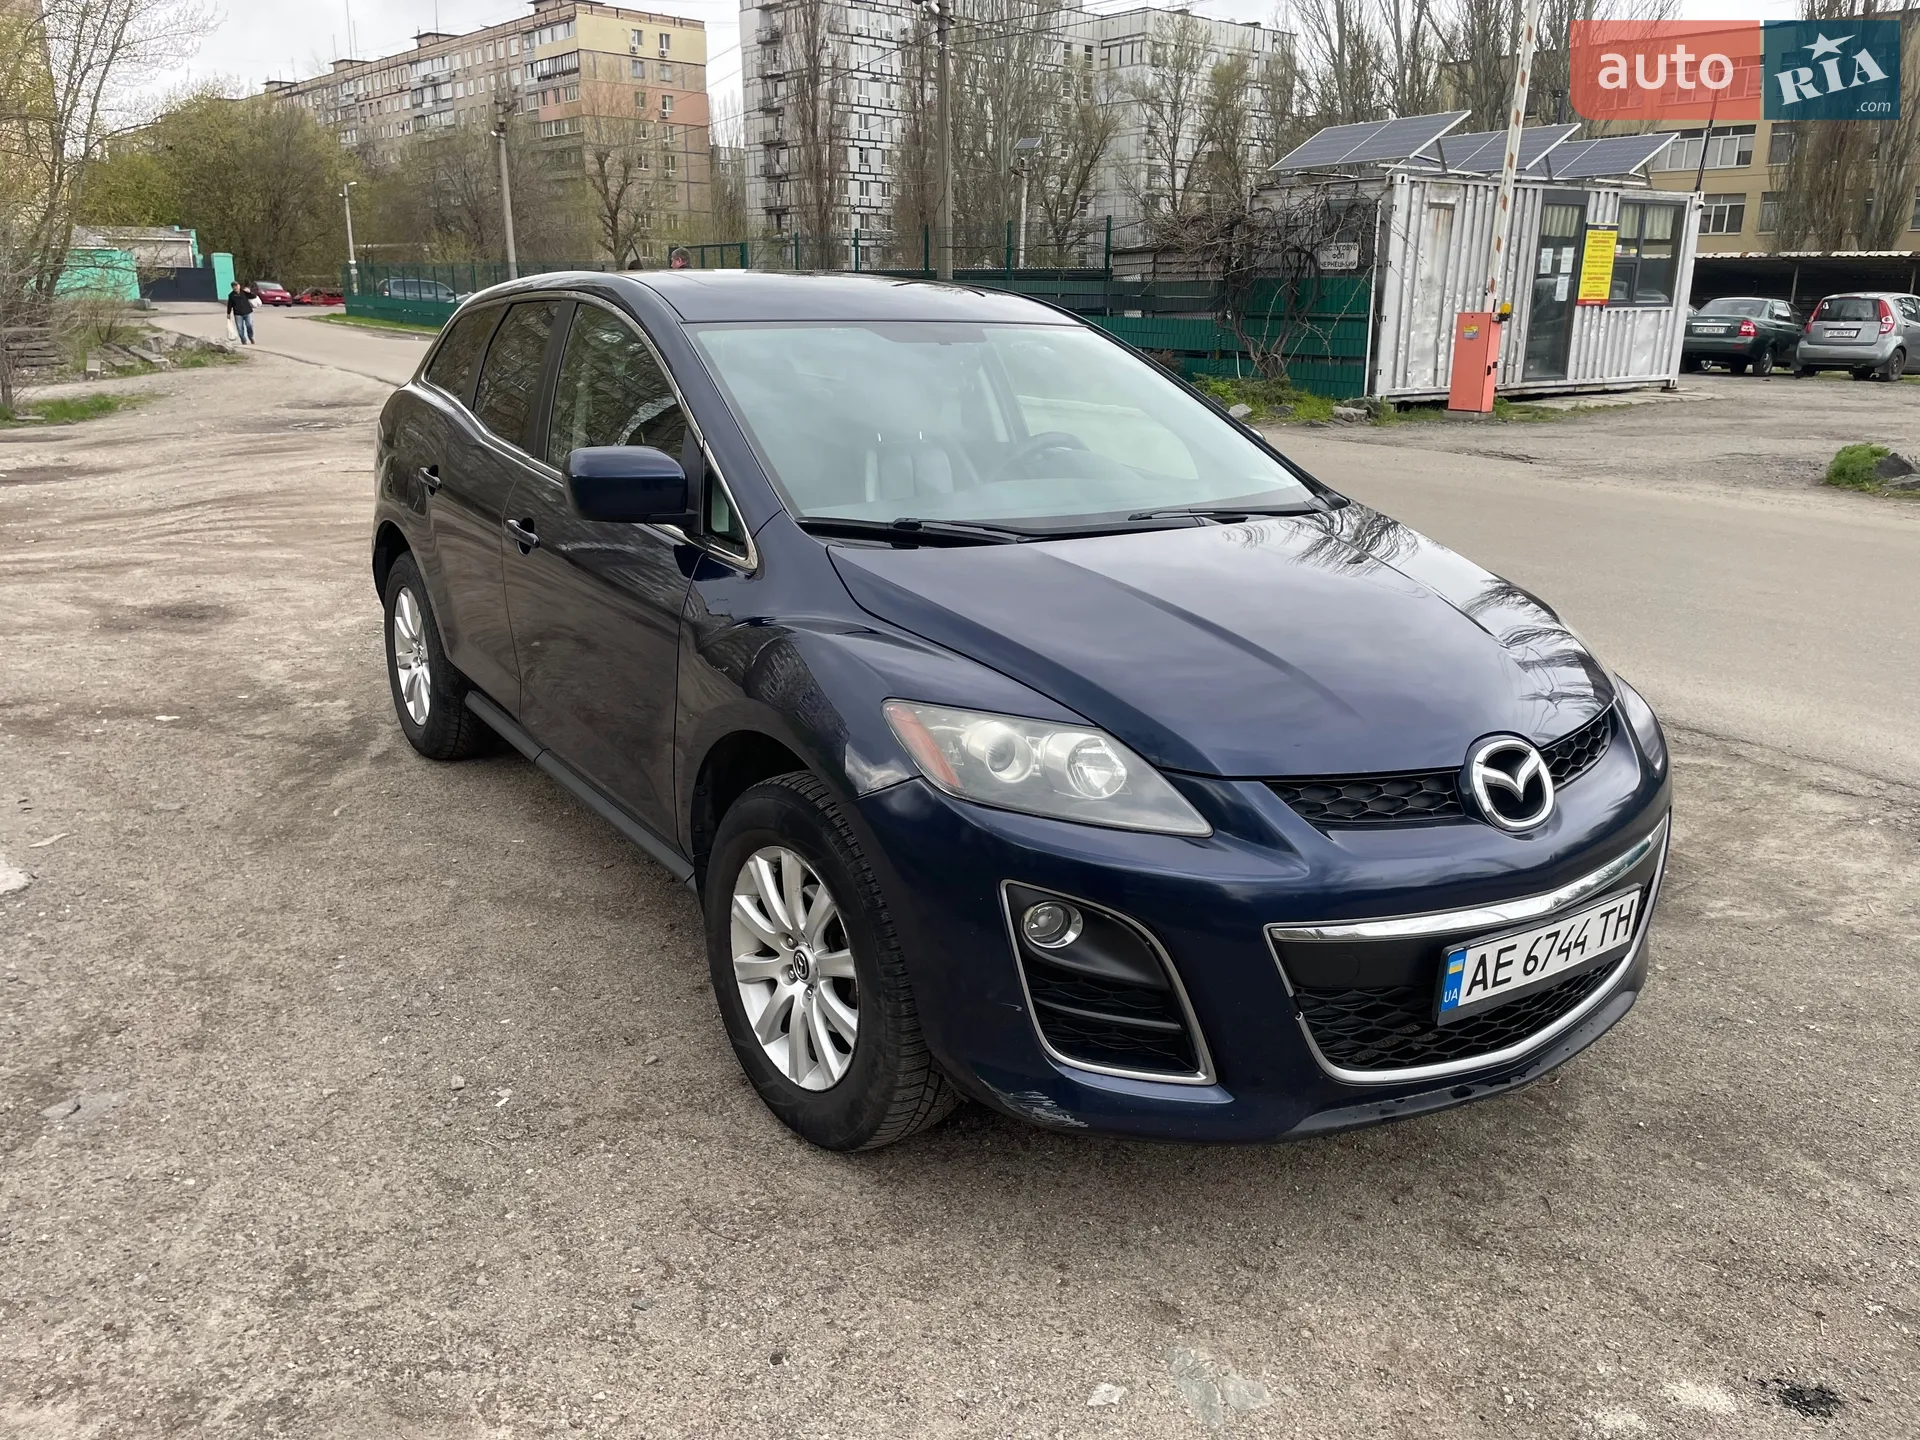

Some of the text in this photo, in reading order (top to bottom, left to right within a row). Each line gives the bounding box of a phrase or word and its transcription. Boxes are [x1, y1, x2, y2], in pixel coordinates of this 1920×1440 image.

[1466, 899, 1635, 997] AE 6744 TH
[1444, 989, 1458, 1003] UA
